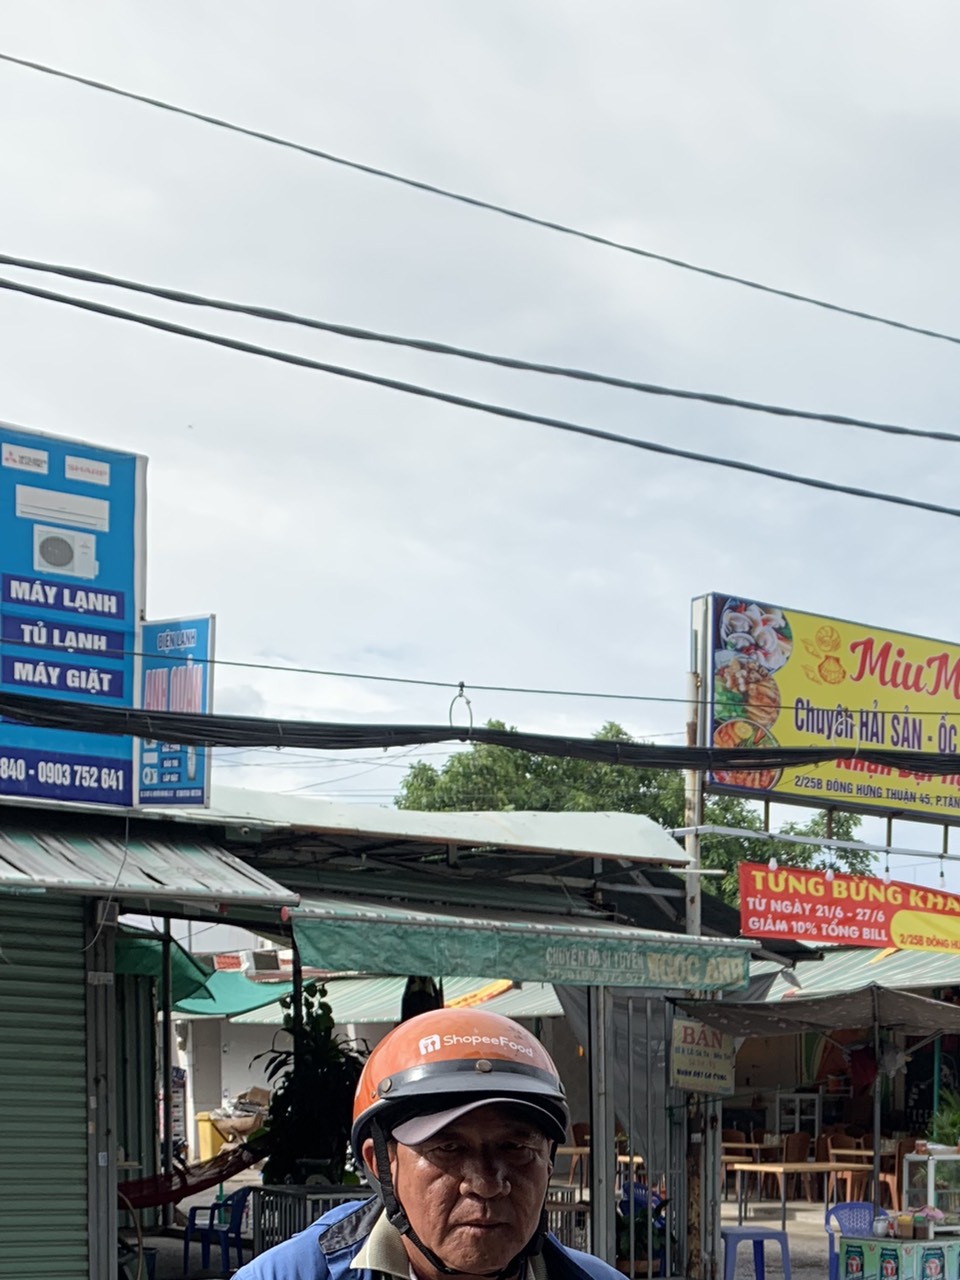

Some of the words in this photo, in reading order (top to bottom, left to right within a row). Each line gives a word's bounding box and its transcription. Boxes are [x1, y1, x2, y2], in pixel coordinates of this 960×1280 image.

[10, 580, 58, 605] MÁY
[63, 589, 117, 613] LẠNH
[21, 621, 47, 644] TỦ
[53, 629, 107, 653] LẠNH
[14, 661, 60, 685] MÁY
[66, 669, 112, 694] GIẶT
[795, 698, 854, 741] Chuyên
[860, 700, 885, 744] HẢI
[891, 706, 922, 750] SẢN
[938, 711, 957, 754] ỐC
[38, 761, 70, 786] 0903
[73, 765, 98, 788] 752
[101, 768, 123, 791] 641
[794, 775, 822, 790] 2/25B
[826, 777, 853, 794] ĐÔNG
[856, 783, 883, 798] HƯNG
[886, 788, 917, 805] THUẬN
[832, 877, 903, 906] BỪNG
[747, 895, 767, 911] TỪ
[770, 898, 811, 916] NGÀY
[815, 905, 844, 919] 21/6
[856, 908, 885, 923] 27/6
[748, 914, 788, 933] GIẢM
[791, 921, 818, 936] 10%
[821, 919, 860, 939] TỔNG
[862, 928, 888, 941] BILL
[899, 933, 924, 946] 2/25B
[926, 935, 950, 950] ĐÔNG
[647, 952, 701, 988] NGỌC
[704, 956, 745, 984] ANH
[443, 1033, 534, 1058] ShopeeFood
